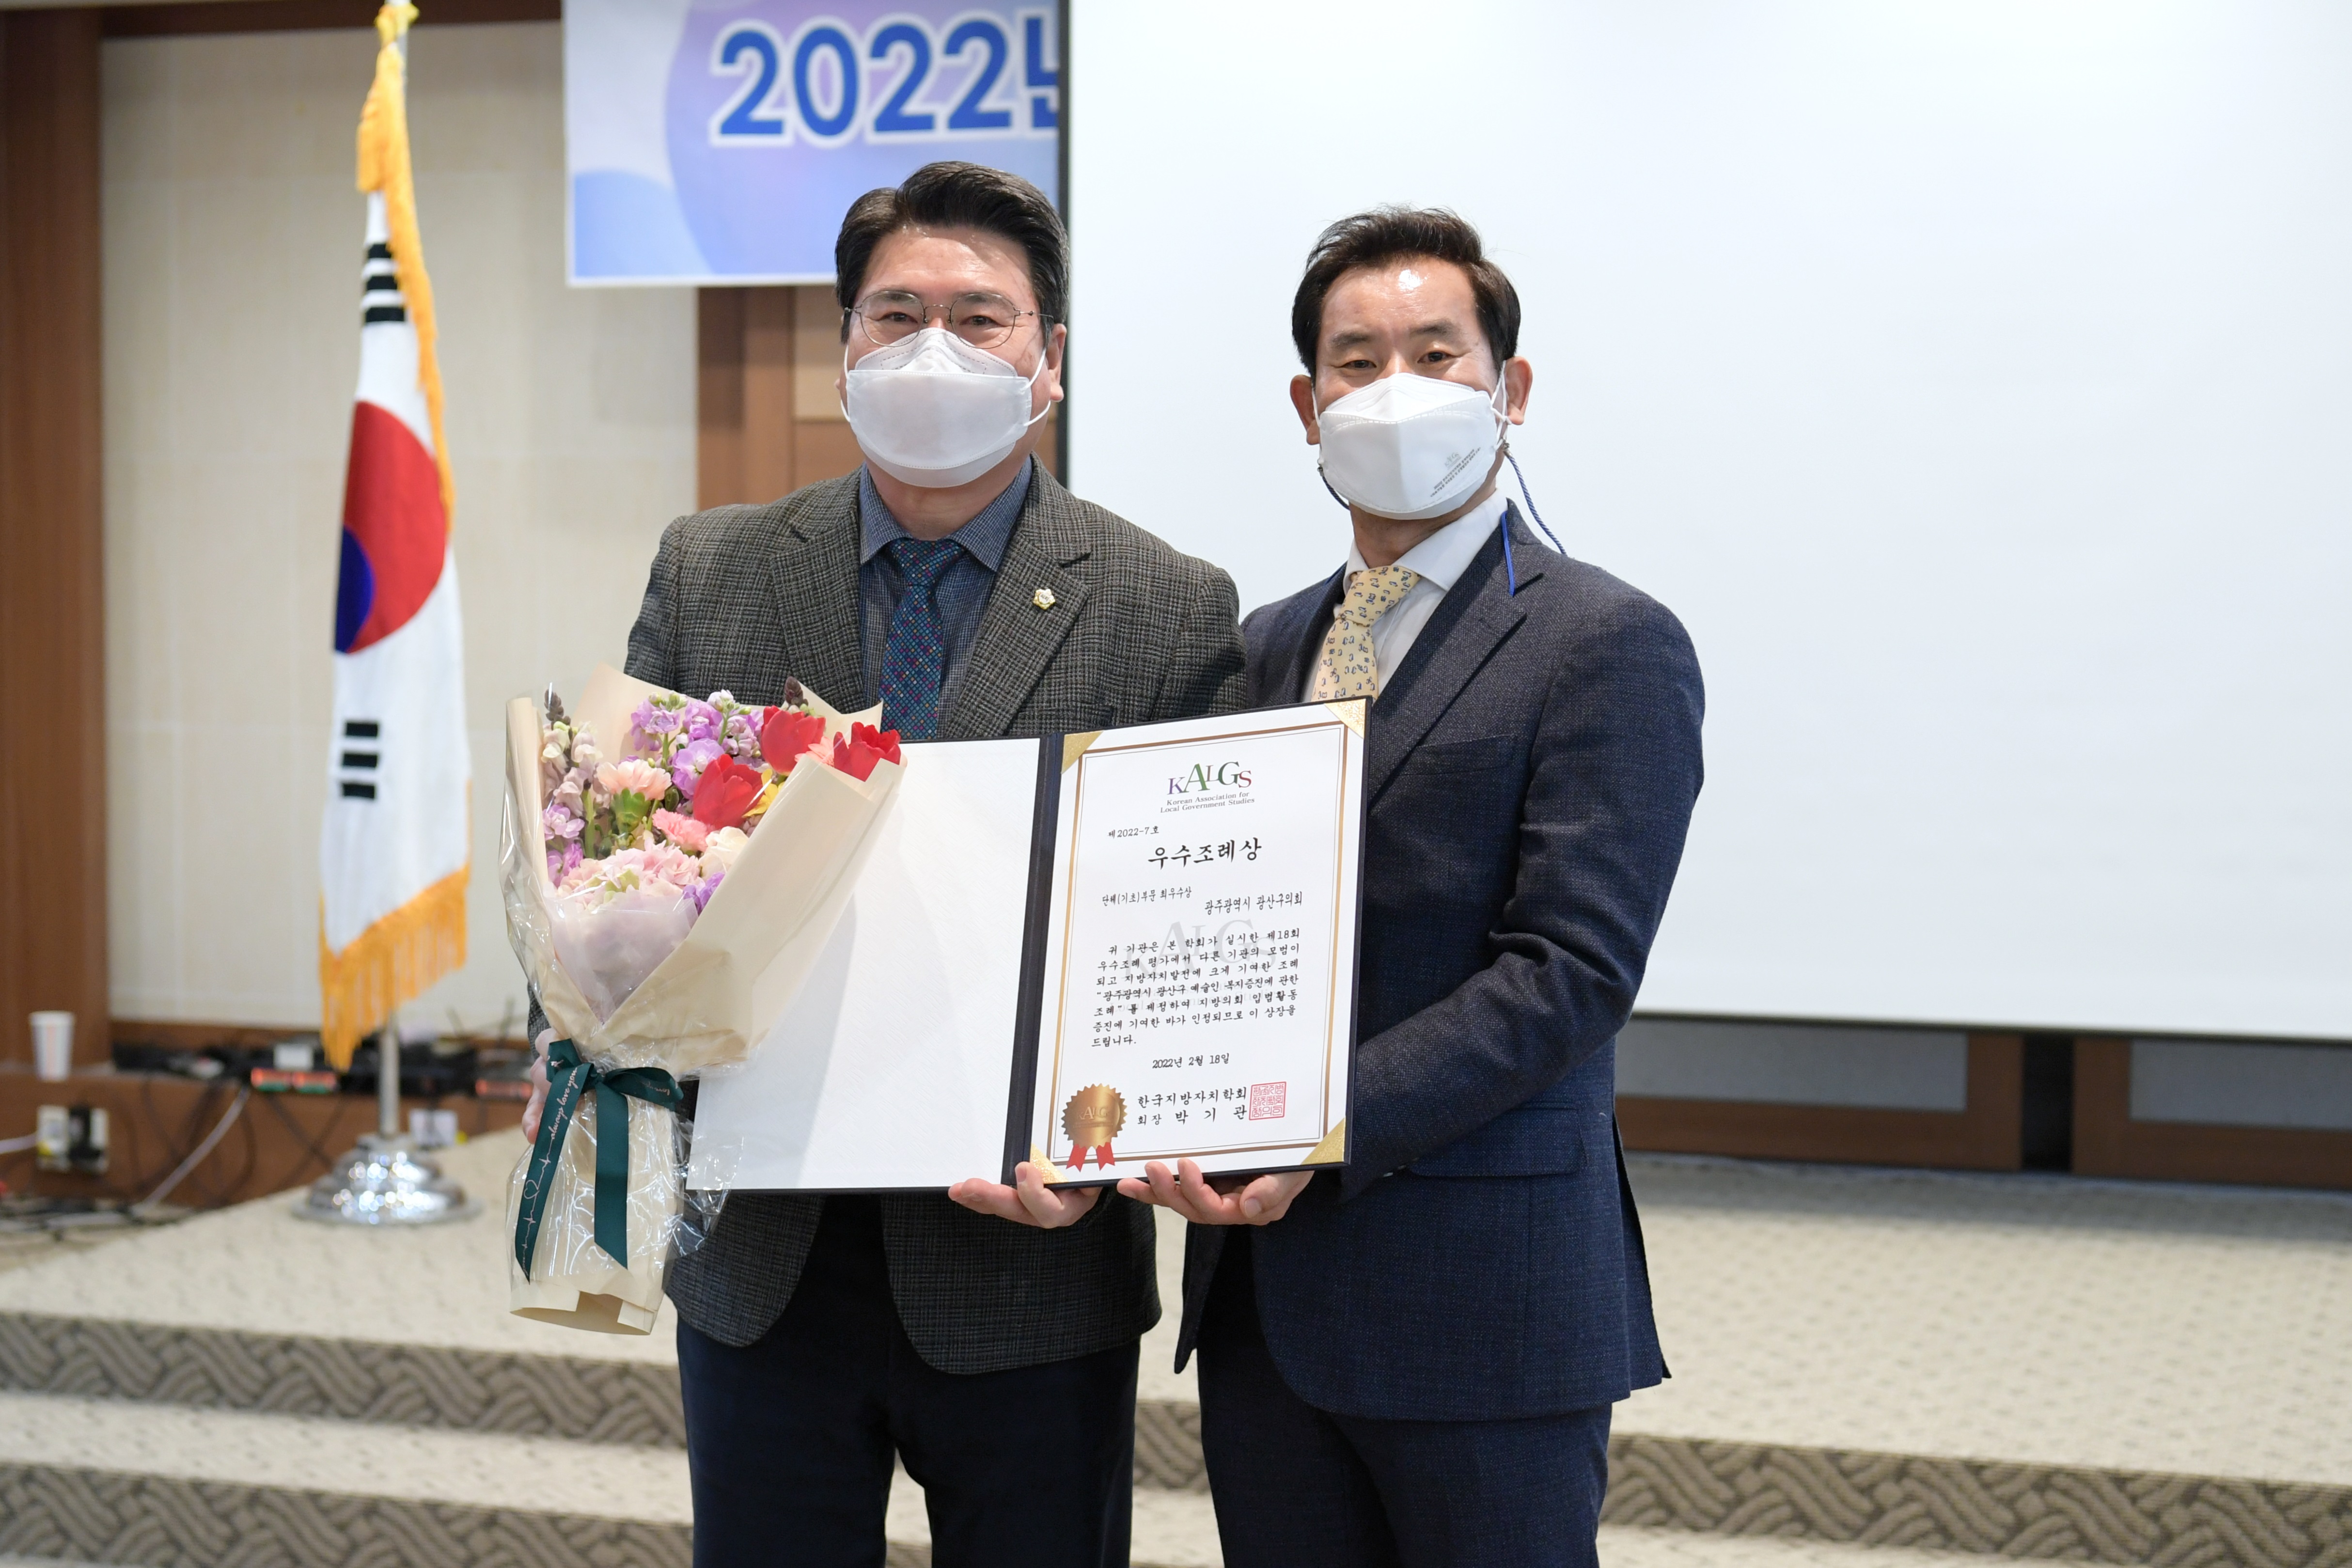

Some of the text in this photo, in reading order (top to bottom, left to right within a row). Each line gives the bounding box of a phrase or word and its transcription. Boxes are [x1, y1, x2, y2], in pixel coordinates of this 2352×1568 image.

[1167, 761, 1252, 795] KALGS
[1160, 797, 1255, 813] Local Government Studies
[1166, 798, 1192, 806] Korean
[1195, 793, 1234, 802] Association
[1148, 837, 1262, 869] 우수조례상
[1102, 886, 1192, 906] 단체(기초)부문 최우수상
[1205, 891, 1302, 915] 광주광역시 광산구의회
[1109, 928, 1299, 955] 귀 기관은 본 학회가 실시한 제18회
[1098, 943, 1299, 971] 우수조례 평가에서 다른 기관의 모범이
[1097, 958, 1298, 986] 되고 지방자치발전에 크게 기여한 조례
[1157, 985, 1186, 997] 광산구
[1191, 981, 1219, 993] 예술인
[1224, 976, 1273, 990] 복지증진에
[1279, 974, 1299, 986] 관한
[1147, 999, 1190, 1012] 제정하여
[1200, 994, 1243, 1007] 지방의회
[1253, 989, 1297, 1004] 입법활동
[1093, 1004, 1296, 1033] 증진에 기여한 바가 인정되므로 이 상장을
[1091, 1035, 1136, 1047] 드립니다.
[1152, 1053, 1229, 1068] 2022년 2월 18일
[548, 1067, 579, 1140] always love you
[1138, 1086, 1246, 1109] 한국지방자치학회
